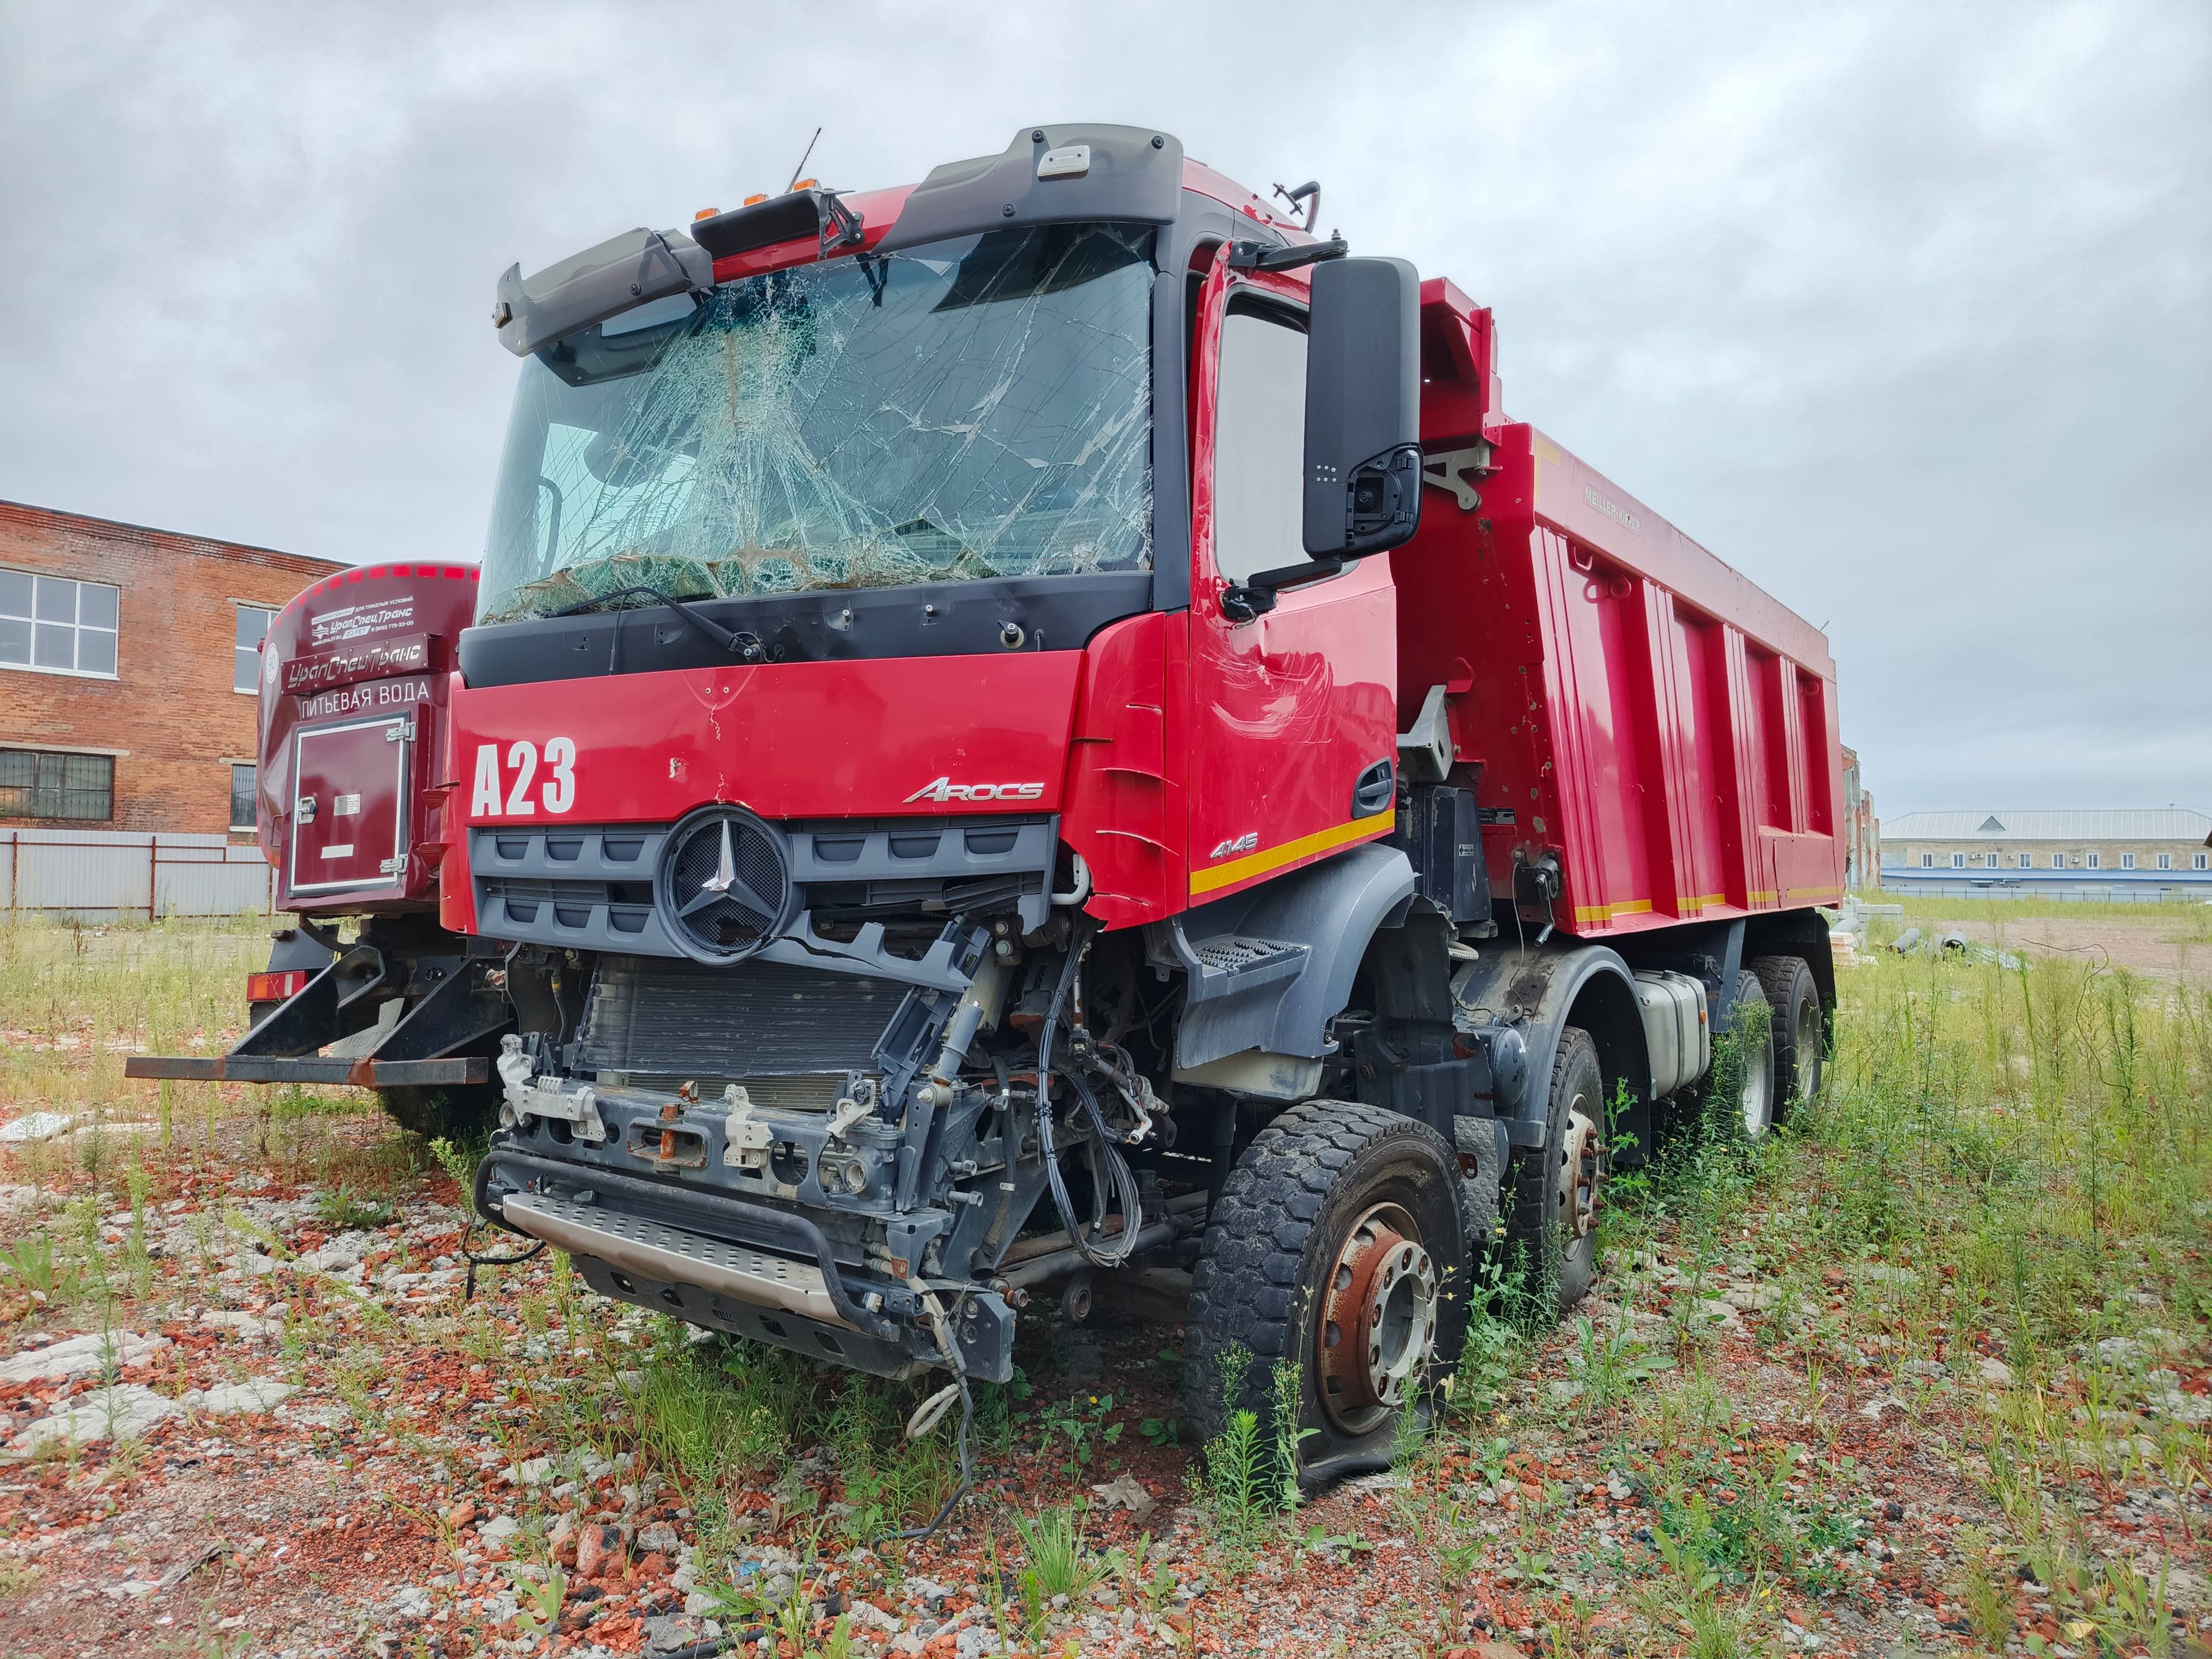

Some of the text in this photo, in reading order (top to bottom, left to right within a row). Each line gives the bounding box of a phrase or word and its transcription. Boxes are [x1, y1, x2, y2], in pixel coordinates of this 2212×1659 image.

[389, 596, 414, 605] УСЛОВИЙ
[355, 627, 366, 635] ЛЕТ
[268, 654, 276, 672] 90
[302, 681, 429, 719] ПИТЬЕВАЯ ВОДА
[471, 736, 576, 817] A23
[902, 777, 1046, 804] AROCS
[1209, 832, 1258, 859] 4145
